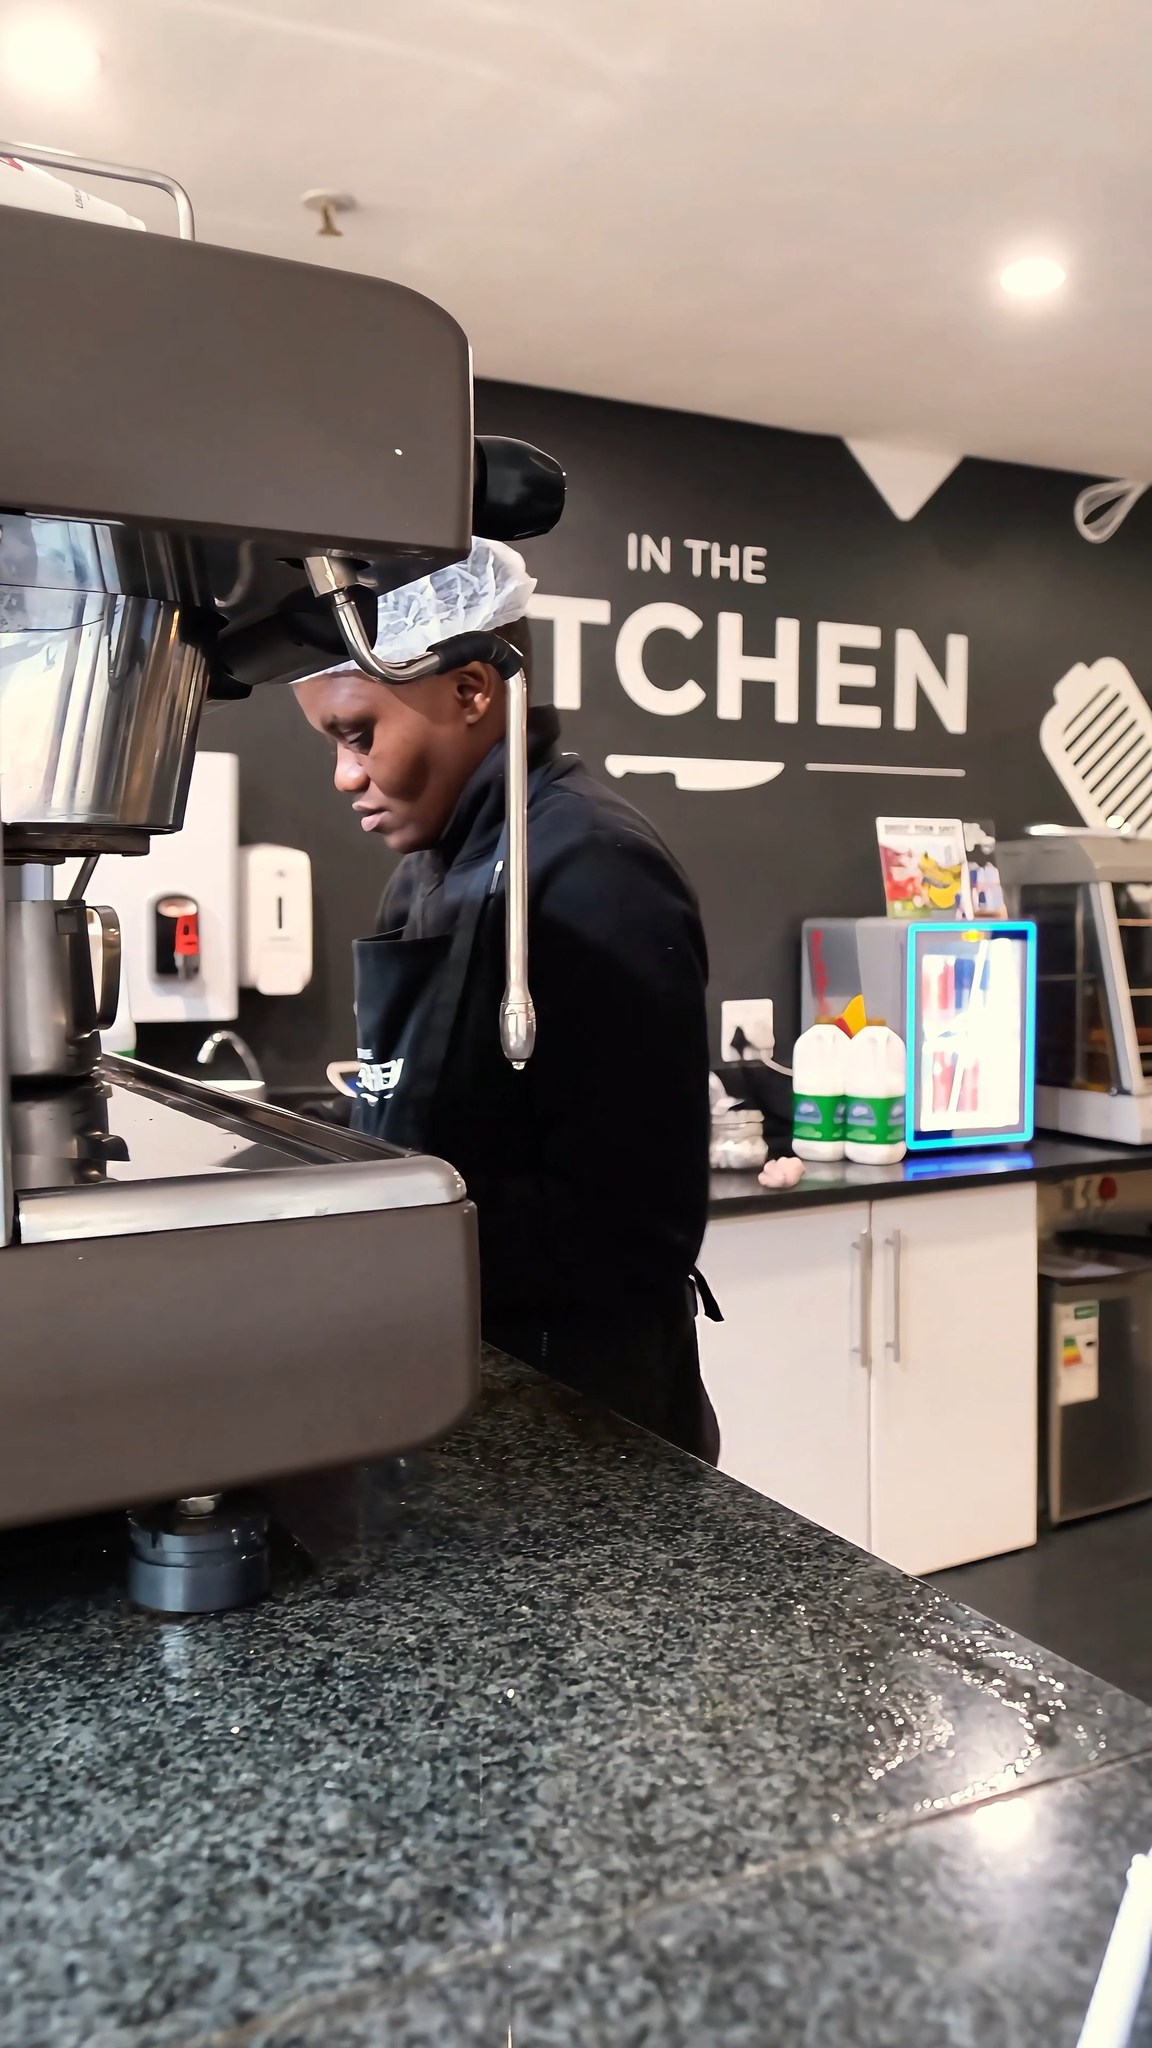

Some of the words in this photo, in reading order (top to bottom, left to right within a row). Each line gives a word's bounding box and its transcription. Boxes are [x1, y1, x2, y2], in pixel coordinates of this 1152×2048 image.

[627, 532, 671, 575] IN
[683, 538, 768, 584] THE
[526, 593, 969, 735] TCHEN
